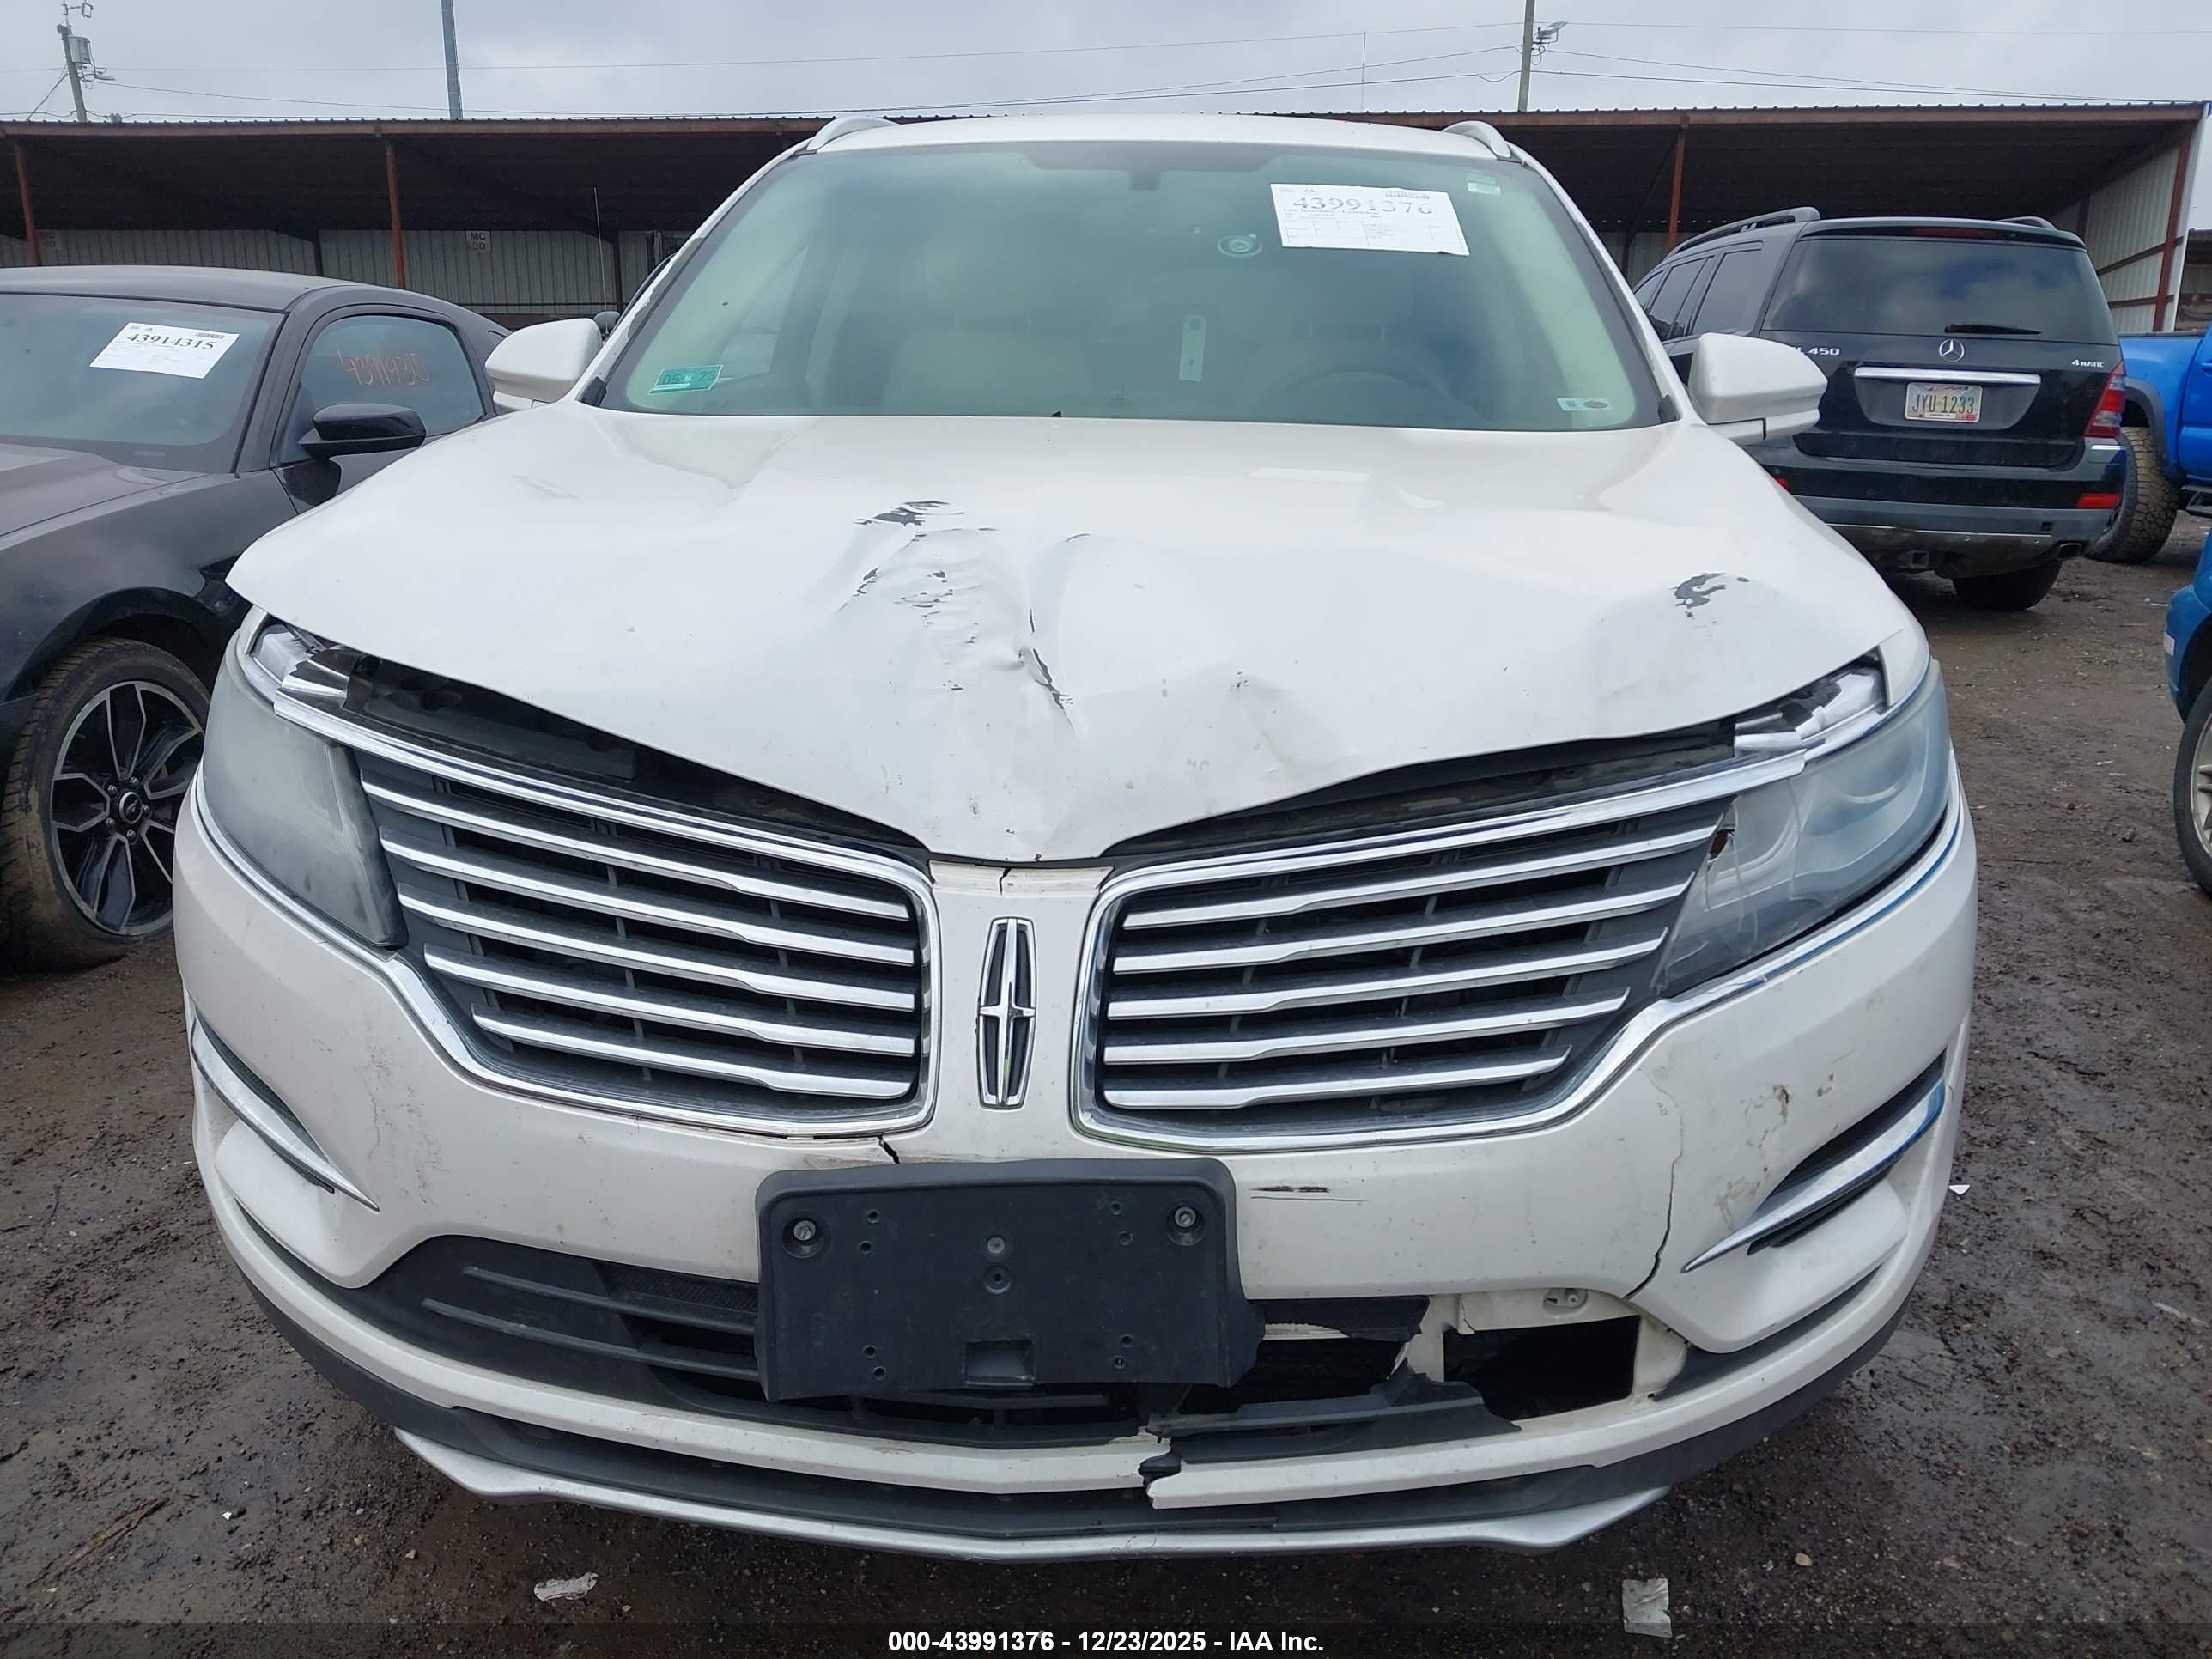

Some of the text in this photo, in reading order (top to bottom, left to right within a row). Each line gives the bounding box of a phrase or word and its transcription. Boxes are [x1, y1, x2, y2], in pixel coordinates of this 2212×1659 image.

[1292, 197, 1433, 215] 43991376
[127, 333, 217, 350] 43914315
[1807, 347, 1841, 356] 450
[1911, 394, 1975, 414] JYU 1233
